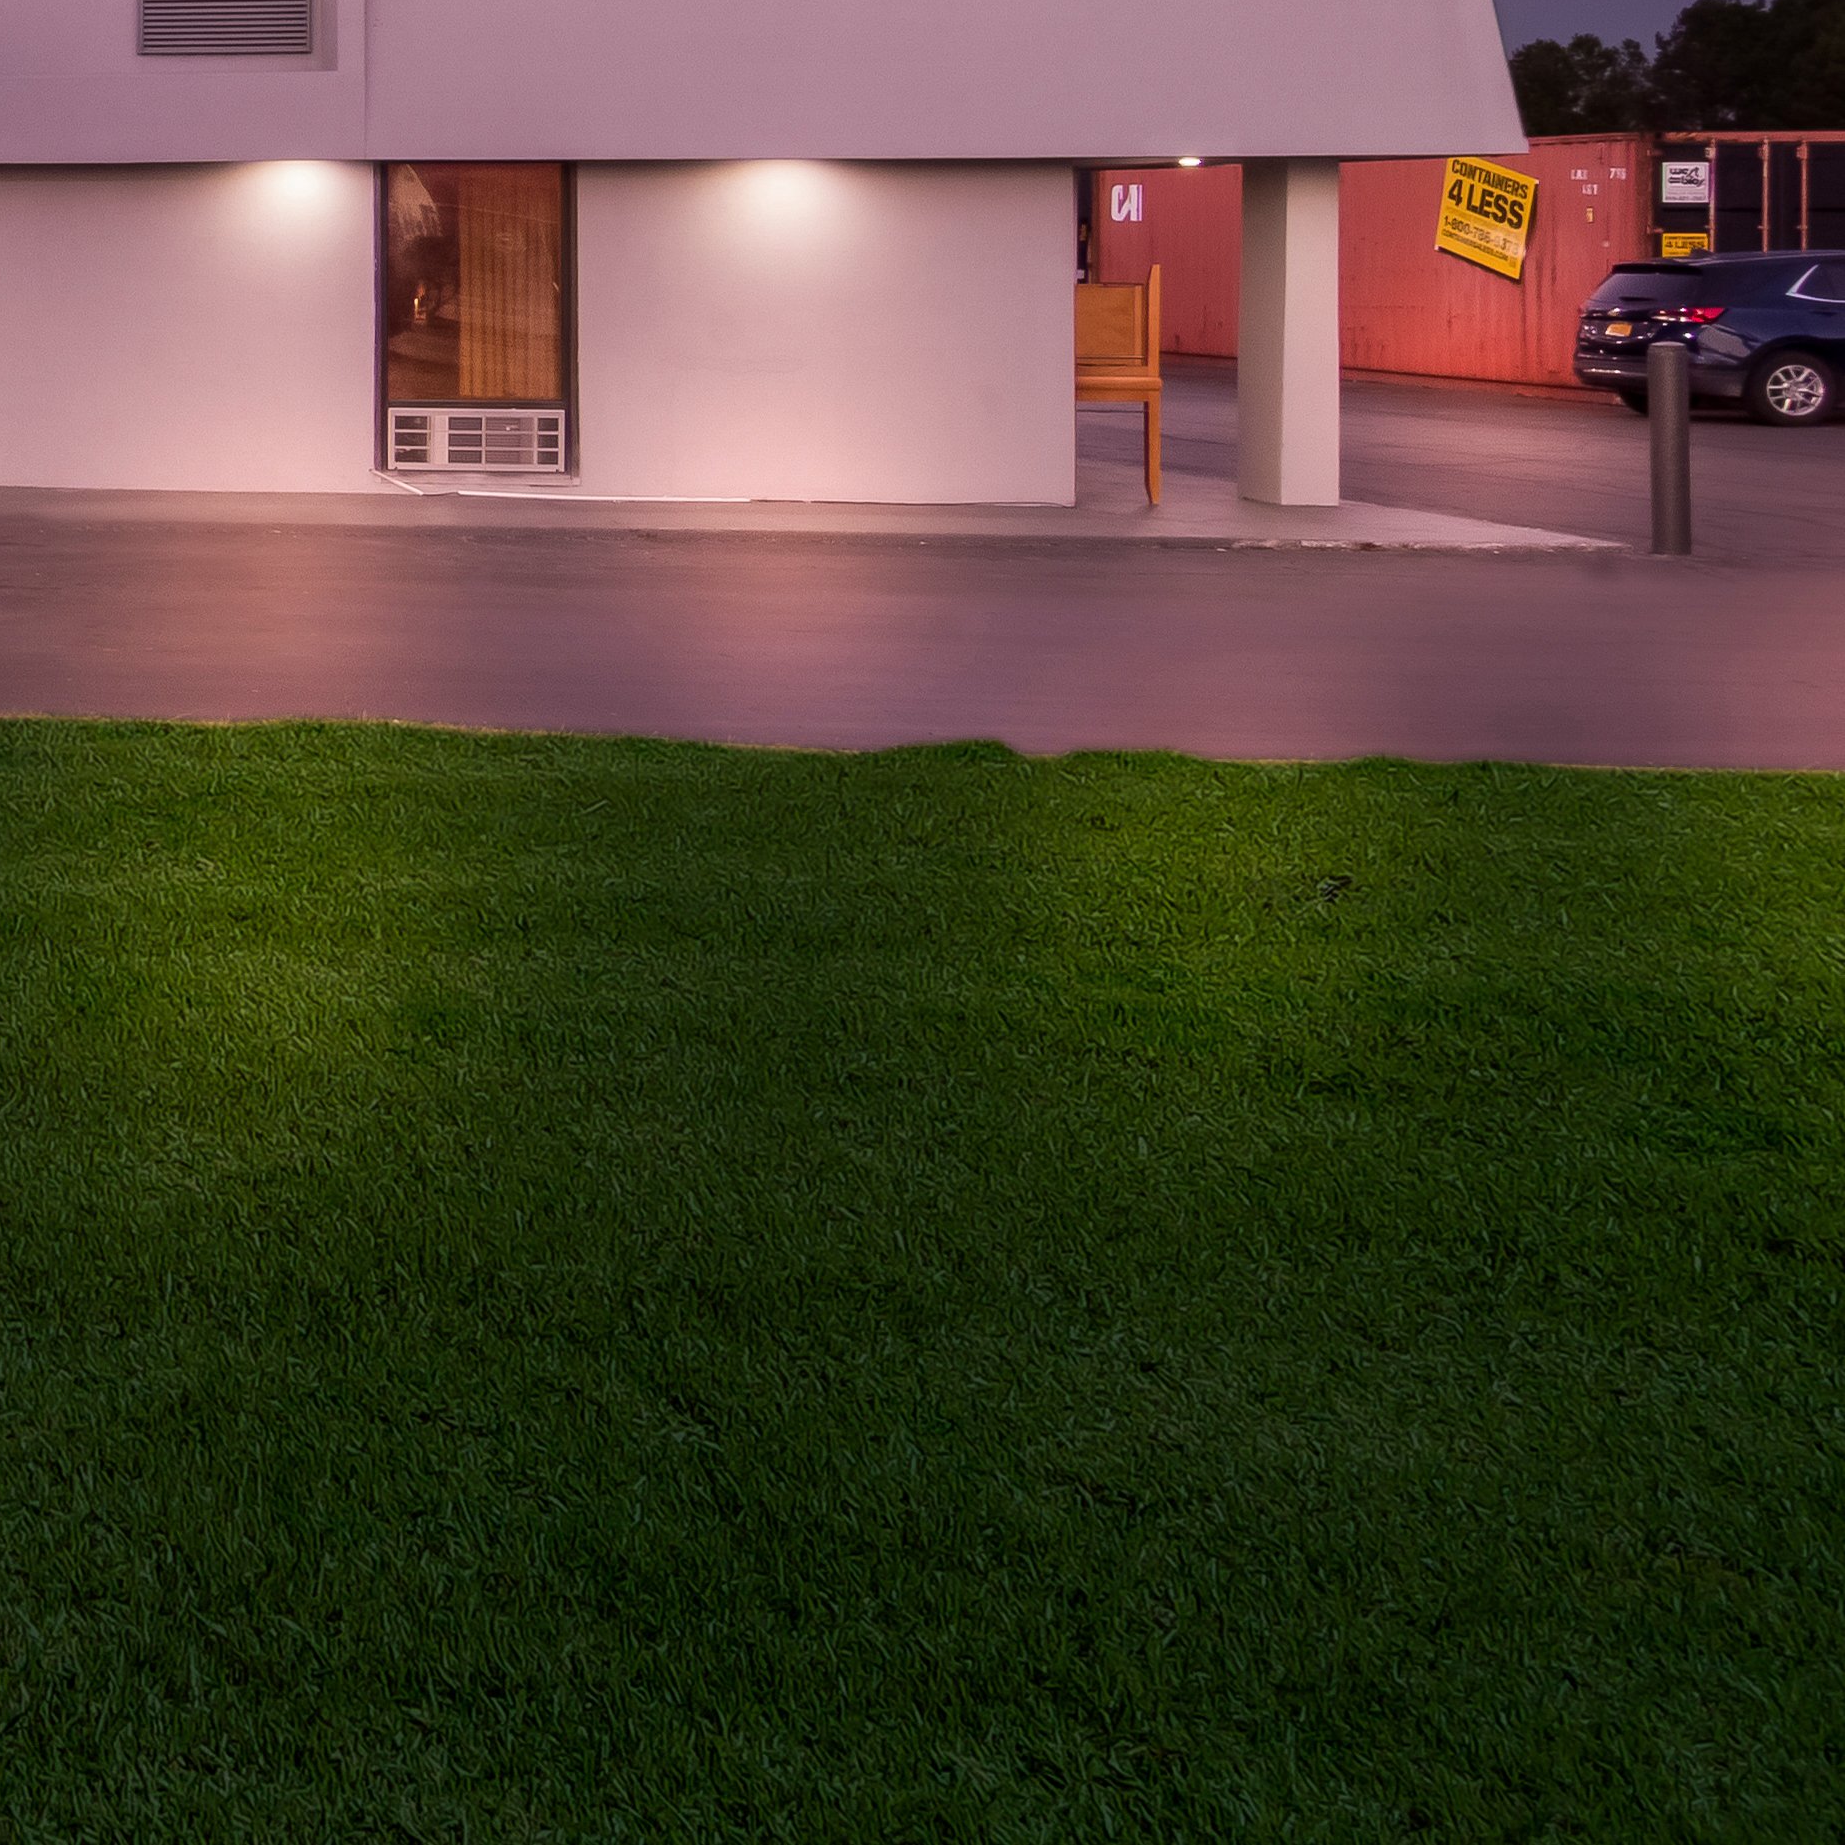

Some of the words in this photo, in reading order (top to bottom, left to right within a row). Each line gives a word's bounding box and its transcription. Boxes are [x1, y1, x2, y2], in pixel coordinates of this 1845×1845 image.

[1452, 159, 1528, 199] CONTAINERS
[1447, 179, 1463, 207] 4
[1466, 183, 1524, 230] LESS
